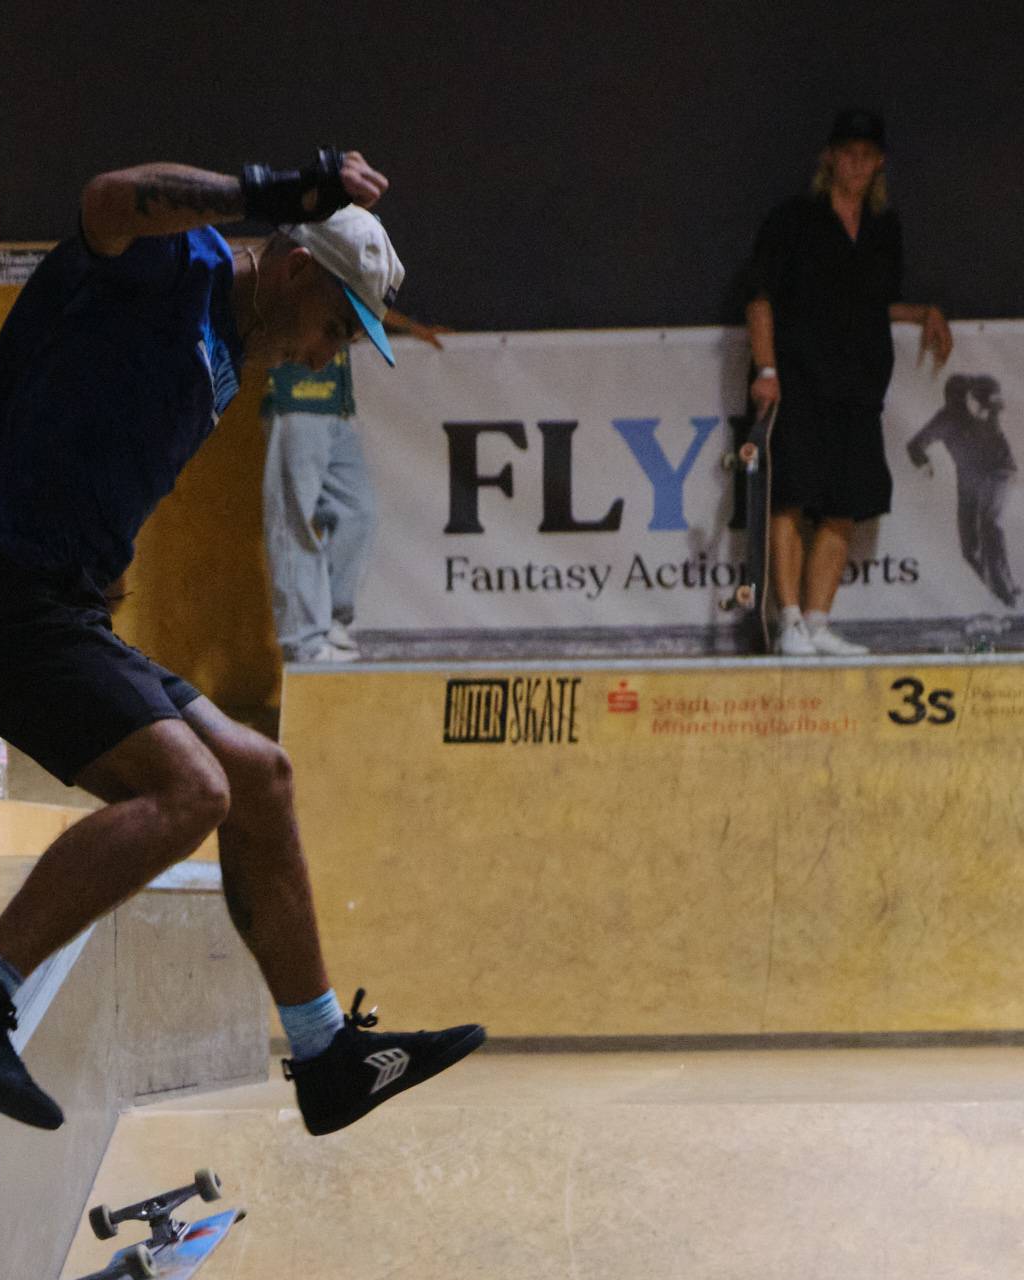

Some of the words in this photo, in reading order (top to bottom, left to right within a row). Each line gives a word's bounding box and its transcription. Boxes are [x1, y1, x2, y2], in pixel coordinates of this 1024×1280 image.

[443, 554, 611, 600] Fantasy
[840, 553, 919, 587] orts
[511, 676, 581, 743] SKATE
[888, 677, 956, 725] 3s
